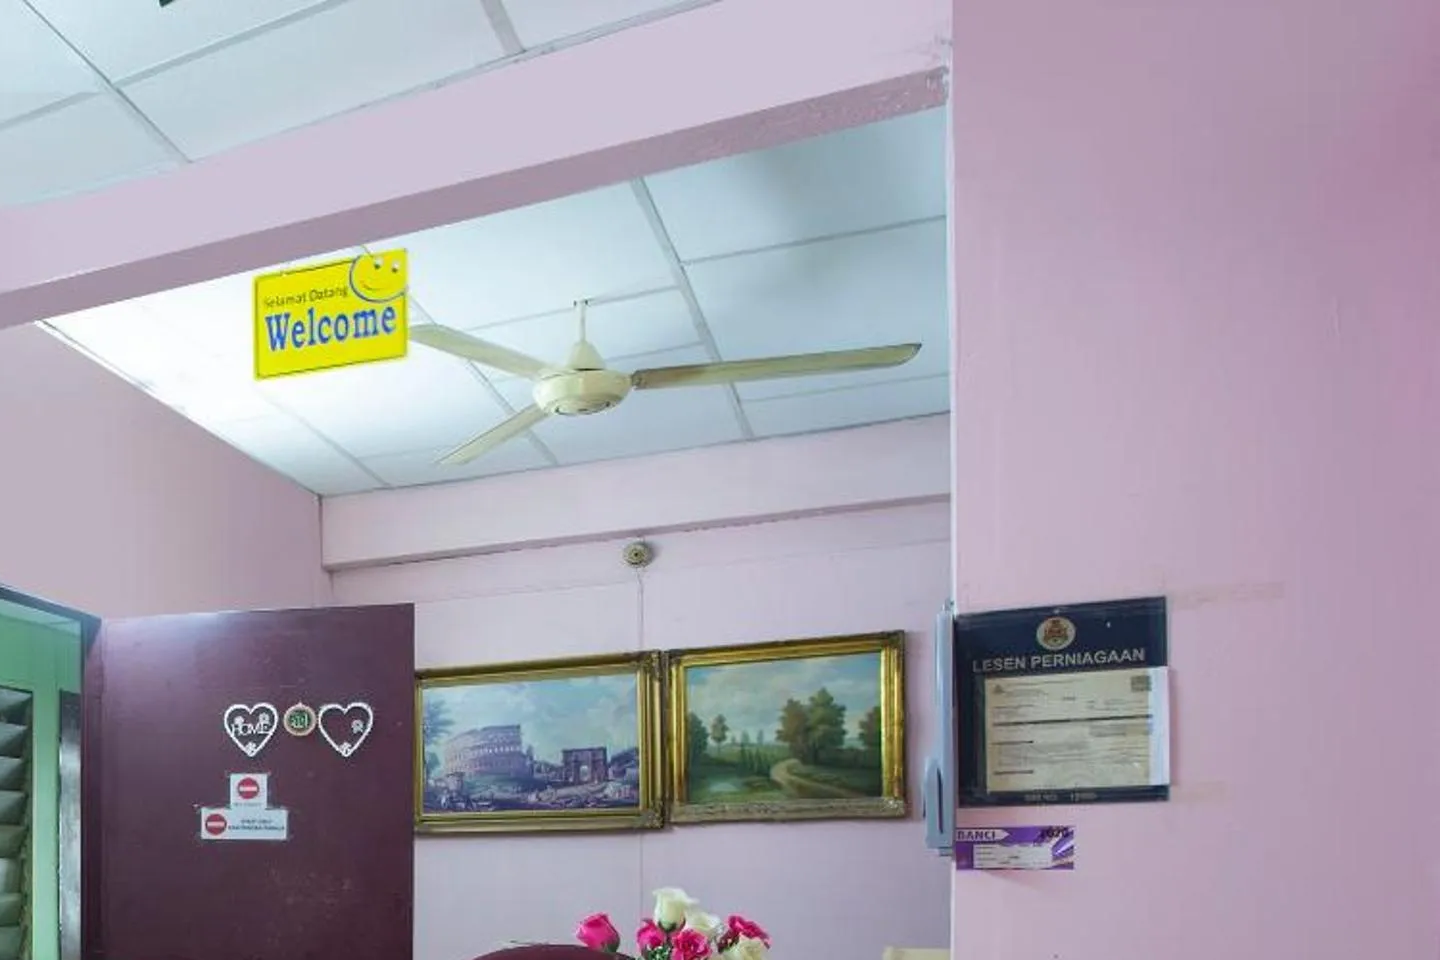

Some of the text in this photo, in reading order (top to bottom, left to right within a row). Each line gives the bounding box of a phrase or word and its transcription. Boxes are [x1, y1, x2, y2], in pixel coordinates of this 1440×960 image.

[265, 306, 396, 351] Welcome
[972, 647, 1146, 673] LESEN PERNIAGAAN
